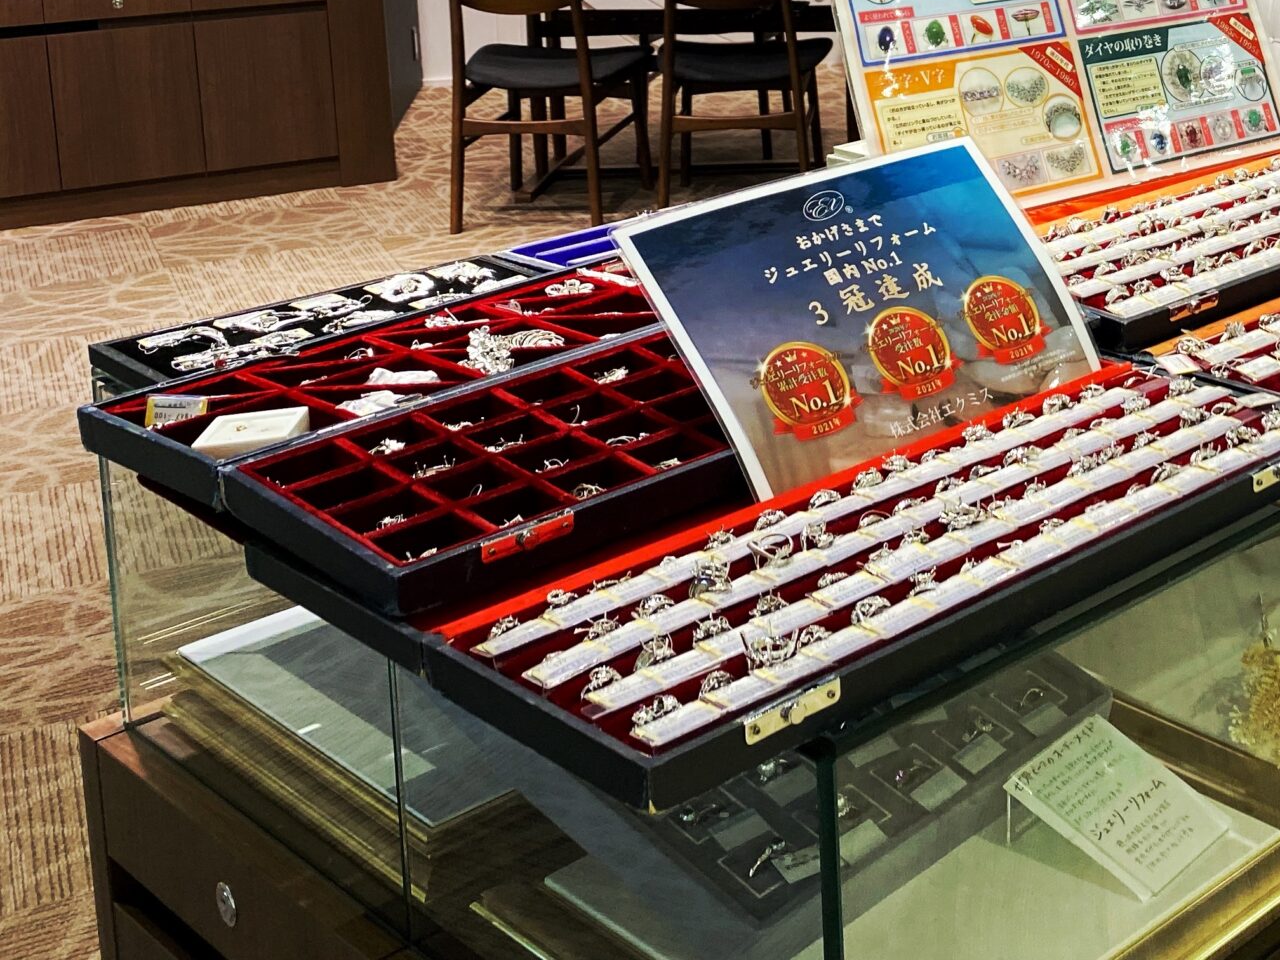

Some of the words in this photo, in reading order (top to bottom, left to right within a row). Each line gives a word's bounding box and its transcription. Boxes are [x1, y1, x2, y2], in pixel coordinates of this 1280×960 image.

[1084, 34, 1163, 58] ダイヤの取り巻き
[796, 214, 883, 250] おかげさまで
[764, 222, 937, 284] ジュエリーリフォーム
[808, 262, 944, 326] 3冠達成
[990, 313, 1034, 347] No.1
[896, 344, 943, 380] No.1
[789, 379, 843, 417] No.1
[890, 387, 994, 439] 株式会社エクミス
